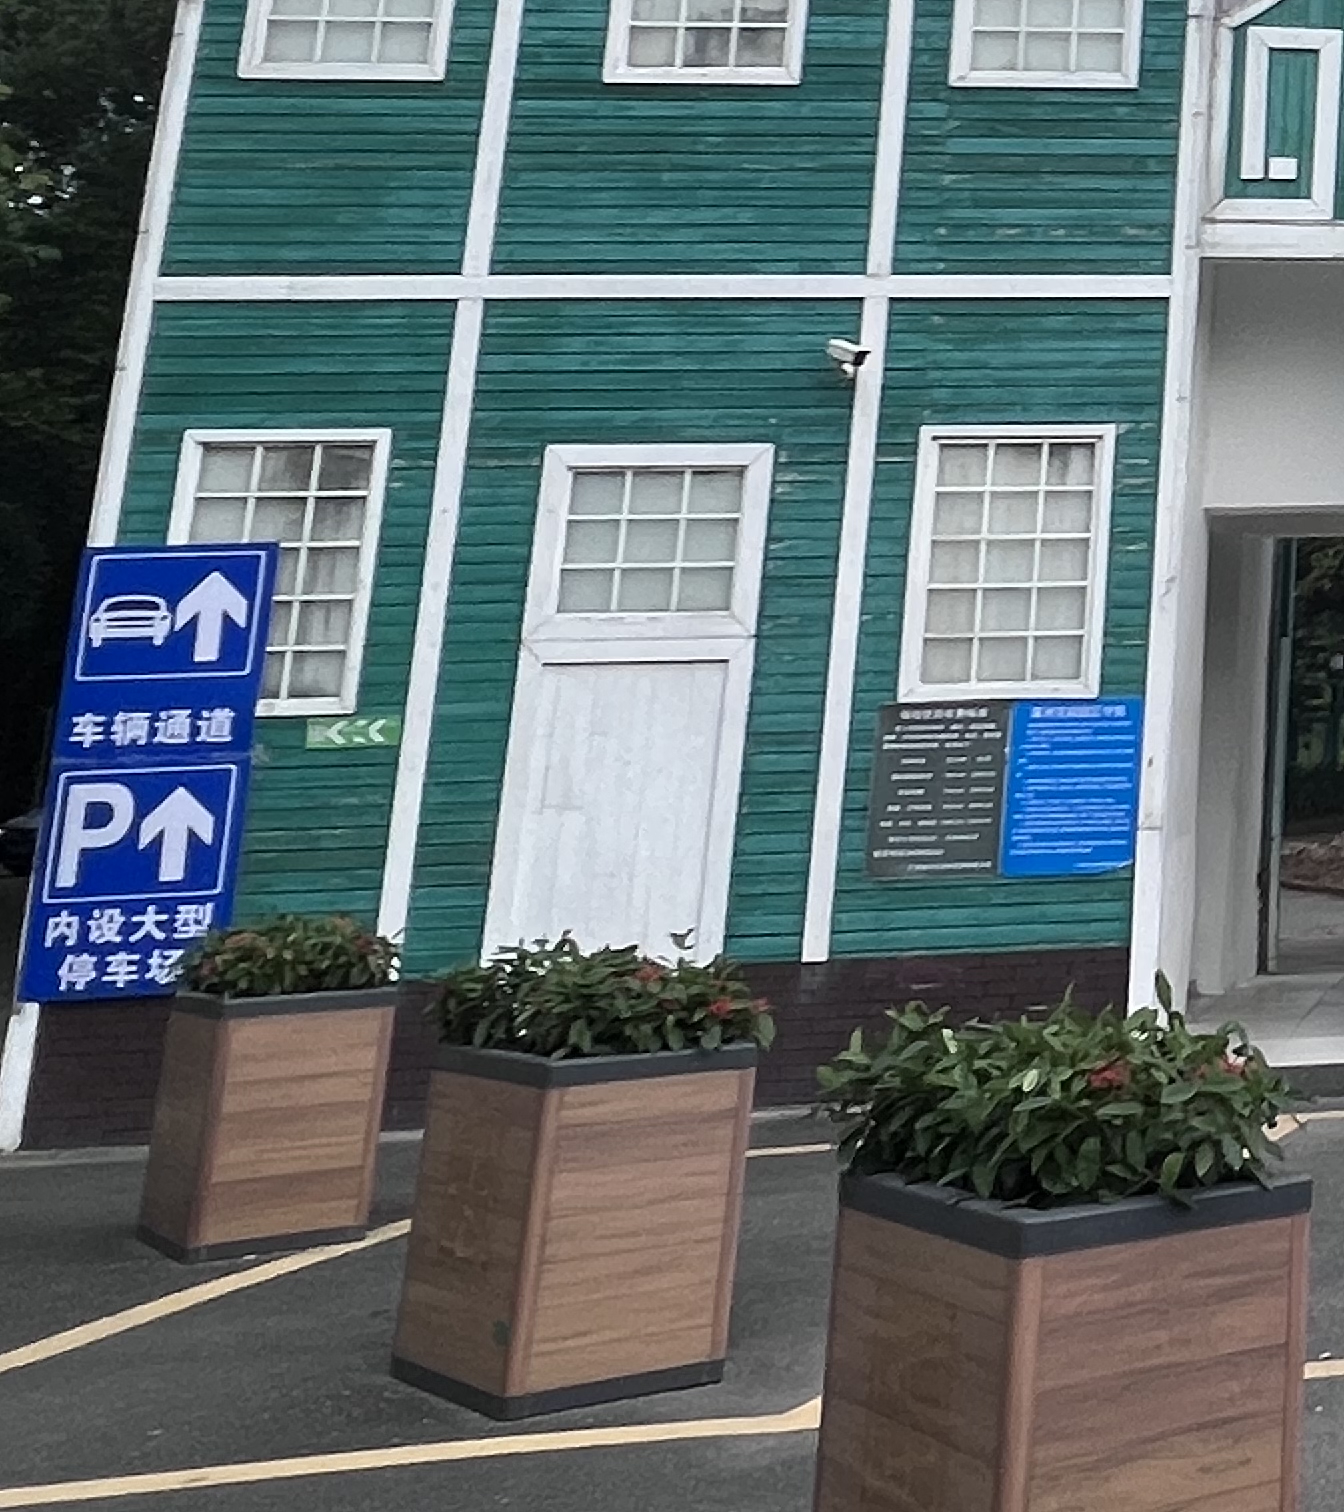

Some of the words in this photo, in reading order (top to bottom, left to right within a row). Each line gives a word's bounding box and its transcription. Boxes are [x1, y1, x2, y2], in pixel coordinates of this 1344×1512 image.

[69, 708, 236, 747] 车辆通道
[55, 782, 135, 888] P
[45, 902, 215, 948] 内设大型
[58, 949, 186, 991] 停车场
